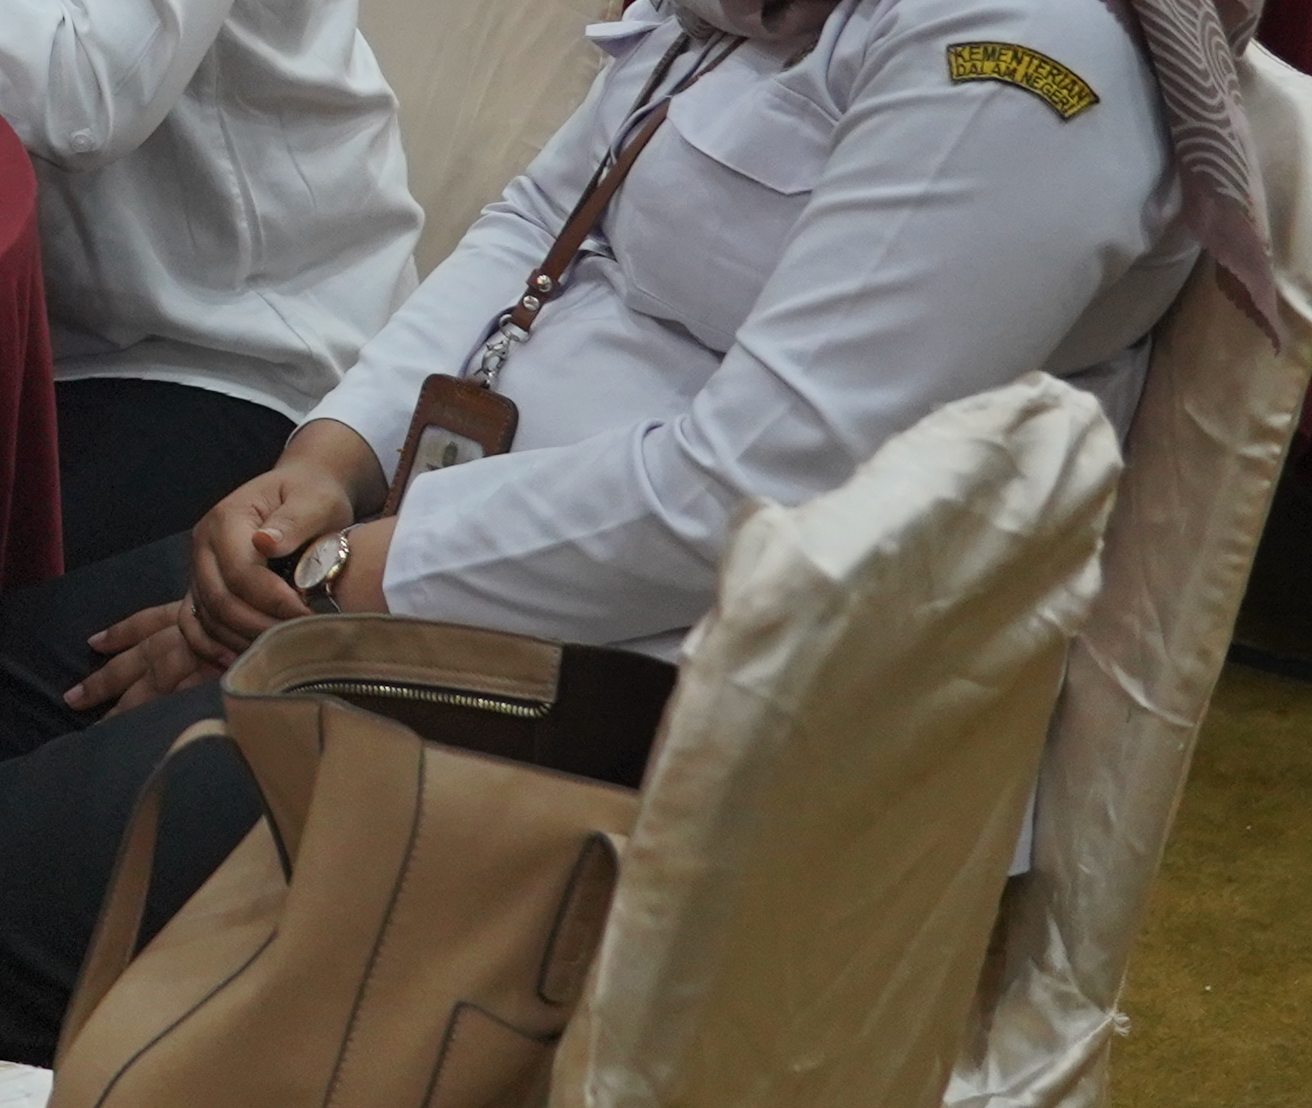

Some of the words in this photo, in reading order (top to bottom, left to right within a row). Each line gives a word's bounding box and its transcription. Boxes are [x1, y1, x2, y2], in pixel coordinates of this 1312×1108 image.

[955, 46, 1088, 101] KEMENTERIAN
[956, 64, 1016, 79] DALAM
[1022, 73, 1076, 112] NEGERI
